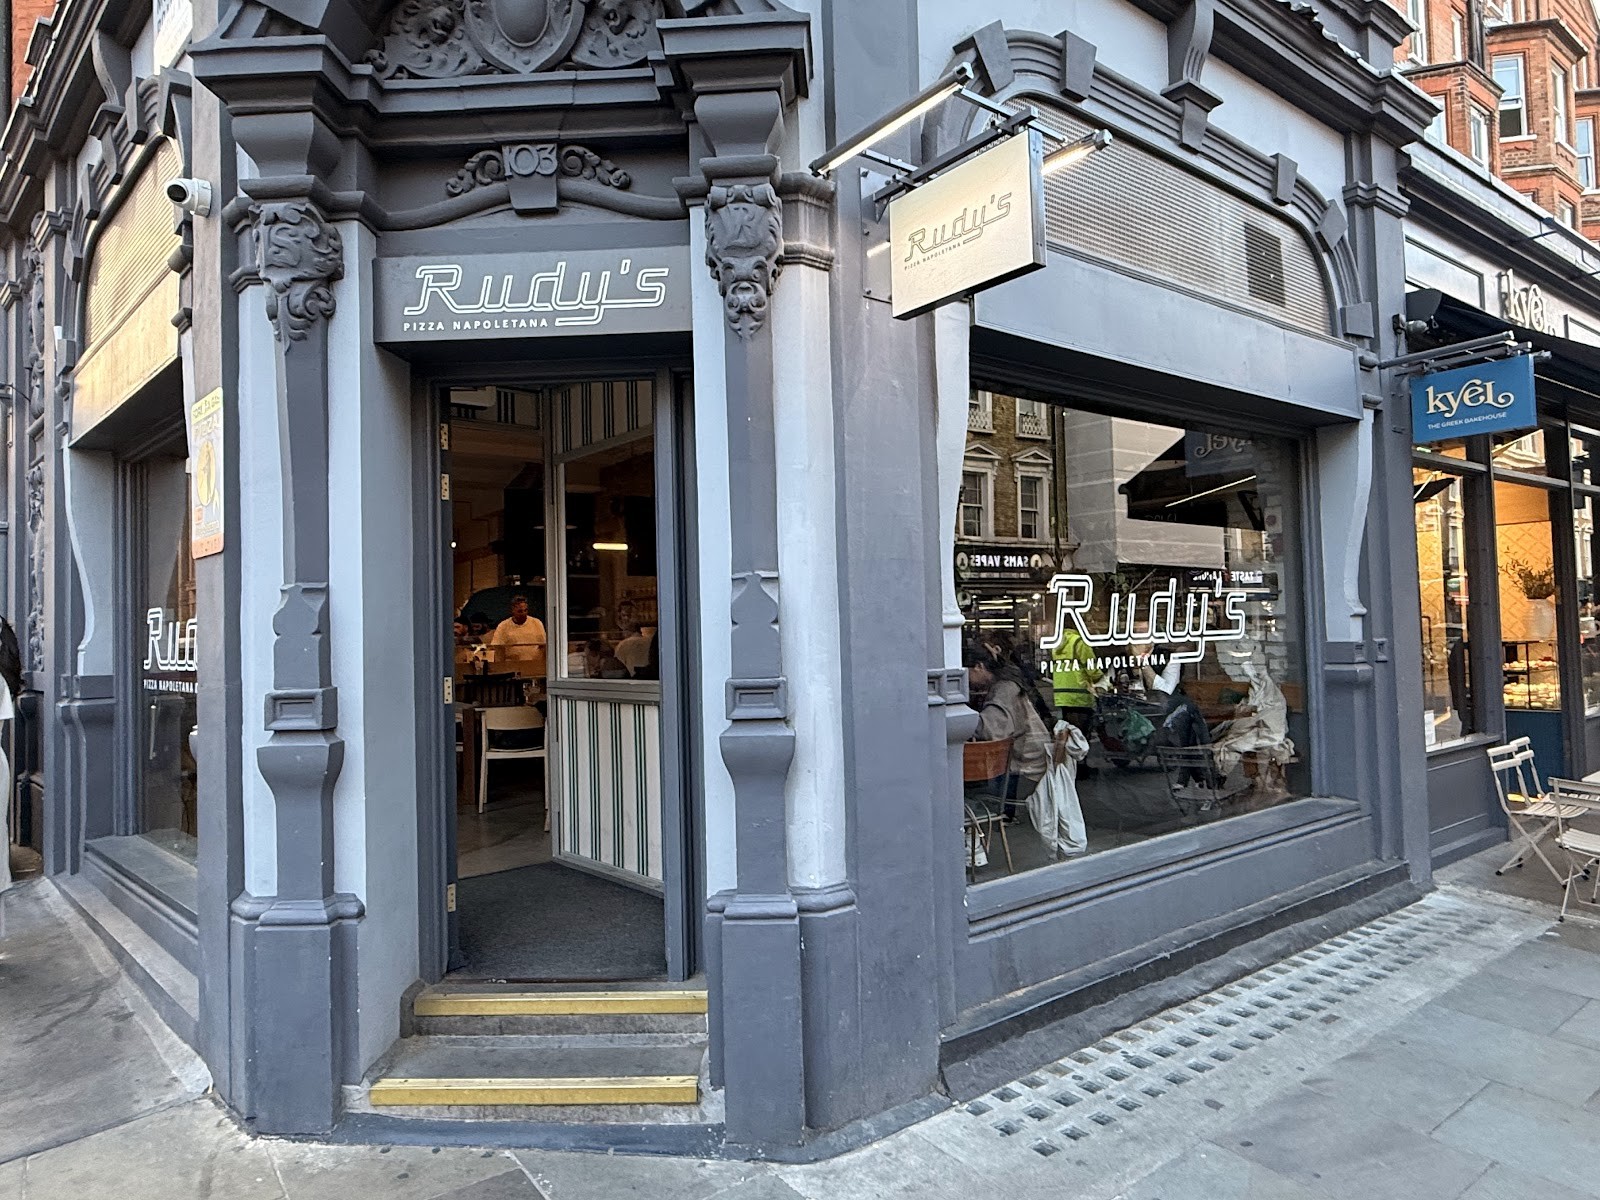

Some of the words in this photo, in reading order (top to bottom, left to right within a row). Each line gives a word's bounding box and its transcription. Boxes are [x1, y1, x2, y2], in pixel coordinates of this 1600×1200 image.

[904, 192, 1012, 262] Rudy's
[403, 259, 670, 326] Rudy's
[403, 321, 445, 332] PIZZA
[453, 318, 548, 330] NAPOLETANA
[1441, 418, 1464, 428] GREEK
[1464, 412, 1507, 424] BAKEHOUSE
[1040, 574, 1247, 663] Rudy's
[1040, 659, 1080, 674] PIZZA
[1087, 654, 1166, 670] NAPOLETANA
[144, 679, 157, 690] PIZZA
[159, 680, 194, 693] NAPOLETANA
